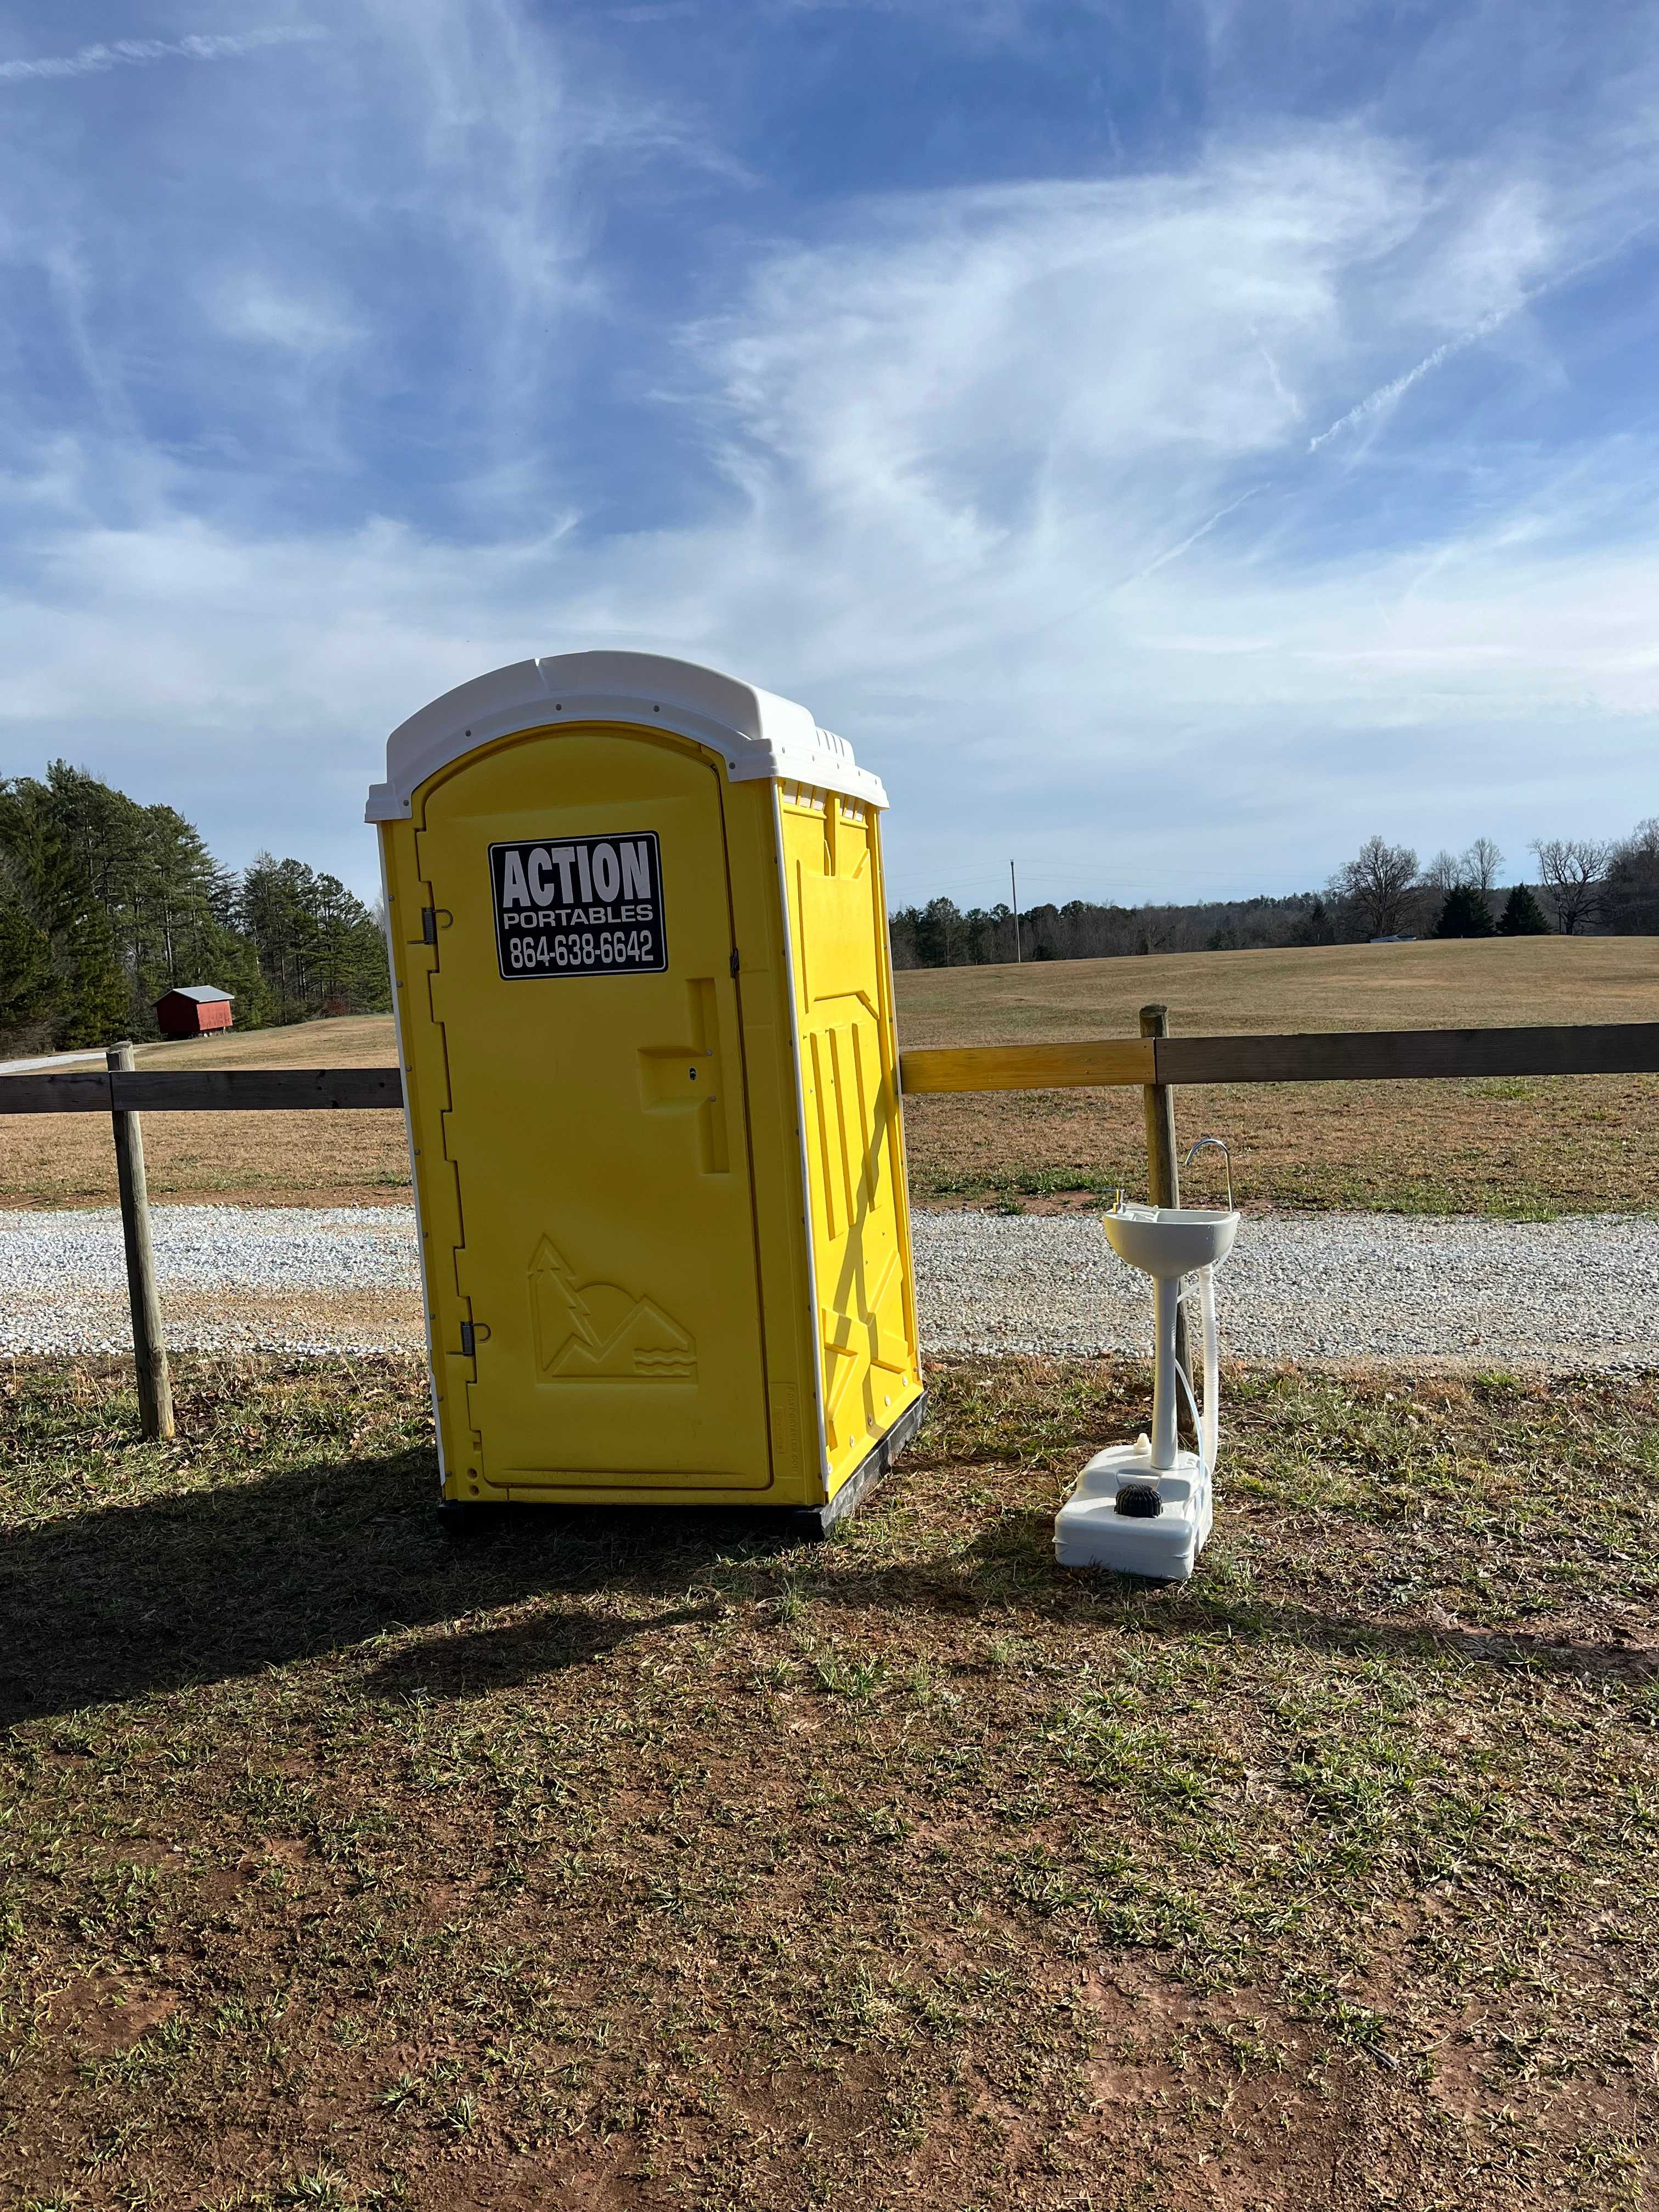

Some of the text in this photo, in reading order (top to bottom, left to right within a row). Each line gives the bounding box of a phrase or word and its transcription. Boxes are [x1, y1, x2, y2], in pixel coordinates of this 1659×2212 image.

[503, 841, 651, 908] ACTION
[503, 904, 653, 929] PORTABLES
[510, 930, 654, 968] 864-638-6642
